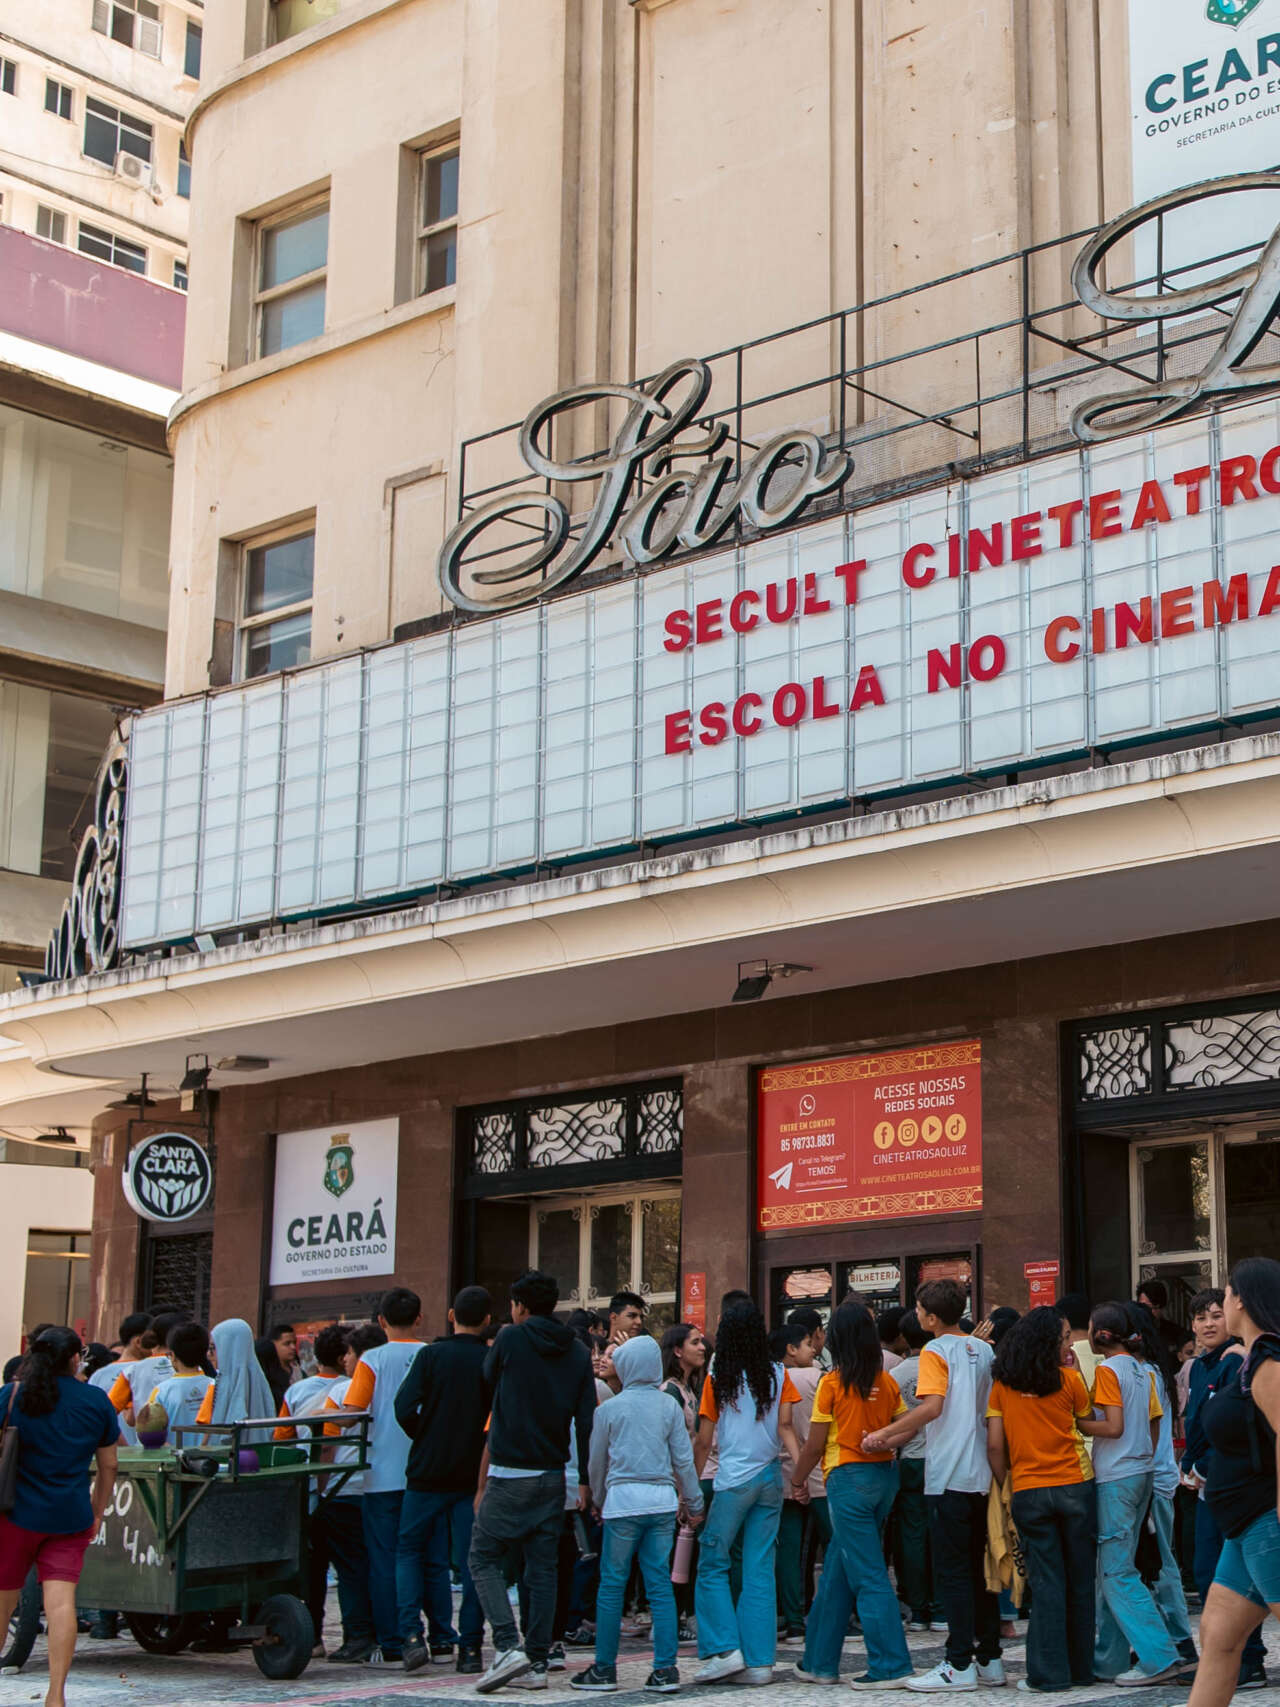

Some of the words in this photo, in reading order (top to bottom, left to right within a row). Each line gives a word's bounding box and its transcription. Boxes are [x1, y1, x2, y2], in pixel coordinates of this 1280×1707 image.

[1145, 98, 1229, 138] GOVERNO
[1235, 87, 1261, 106] DO
[1176, 120, 1237, 148] SECRETARIA
[1238, 114, 1254, 127] DA
[437, 358, 855, 612] São
[663, 558, 867, 653] SECULT
[664, 664, 885, 755] ESCOLA
[927, 635, 1003, 693] NO
[874, 1082, 916, 1100] ACESSE
[919, 1075, 967, 1094] NOSSAS
[884, 1099, 915, 1114] REDES
[917, 1094, 955, 1110] SOCIAIS
[148, 1143, 197, 1161] SANTA
[780, 1138, 791, 1152] 85
[873, 1144, 968, 1165] CINETEATROSAOLUIZ
[142, 1156, 201, 1177] CLARA
[807, 1165, 836, 1177] TEMOS!
[287, 1198, 388, 1249] CEARÁ
[286, 1248, 332, 1264] GOVERNO
[333, 1246, 348, 1259] DO
[349, 1243, 388, 1257] ESTADO
[849, 1271, 900, 1283] BILHETERIA
